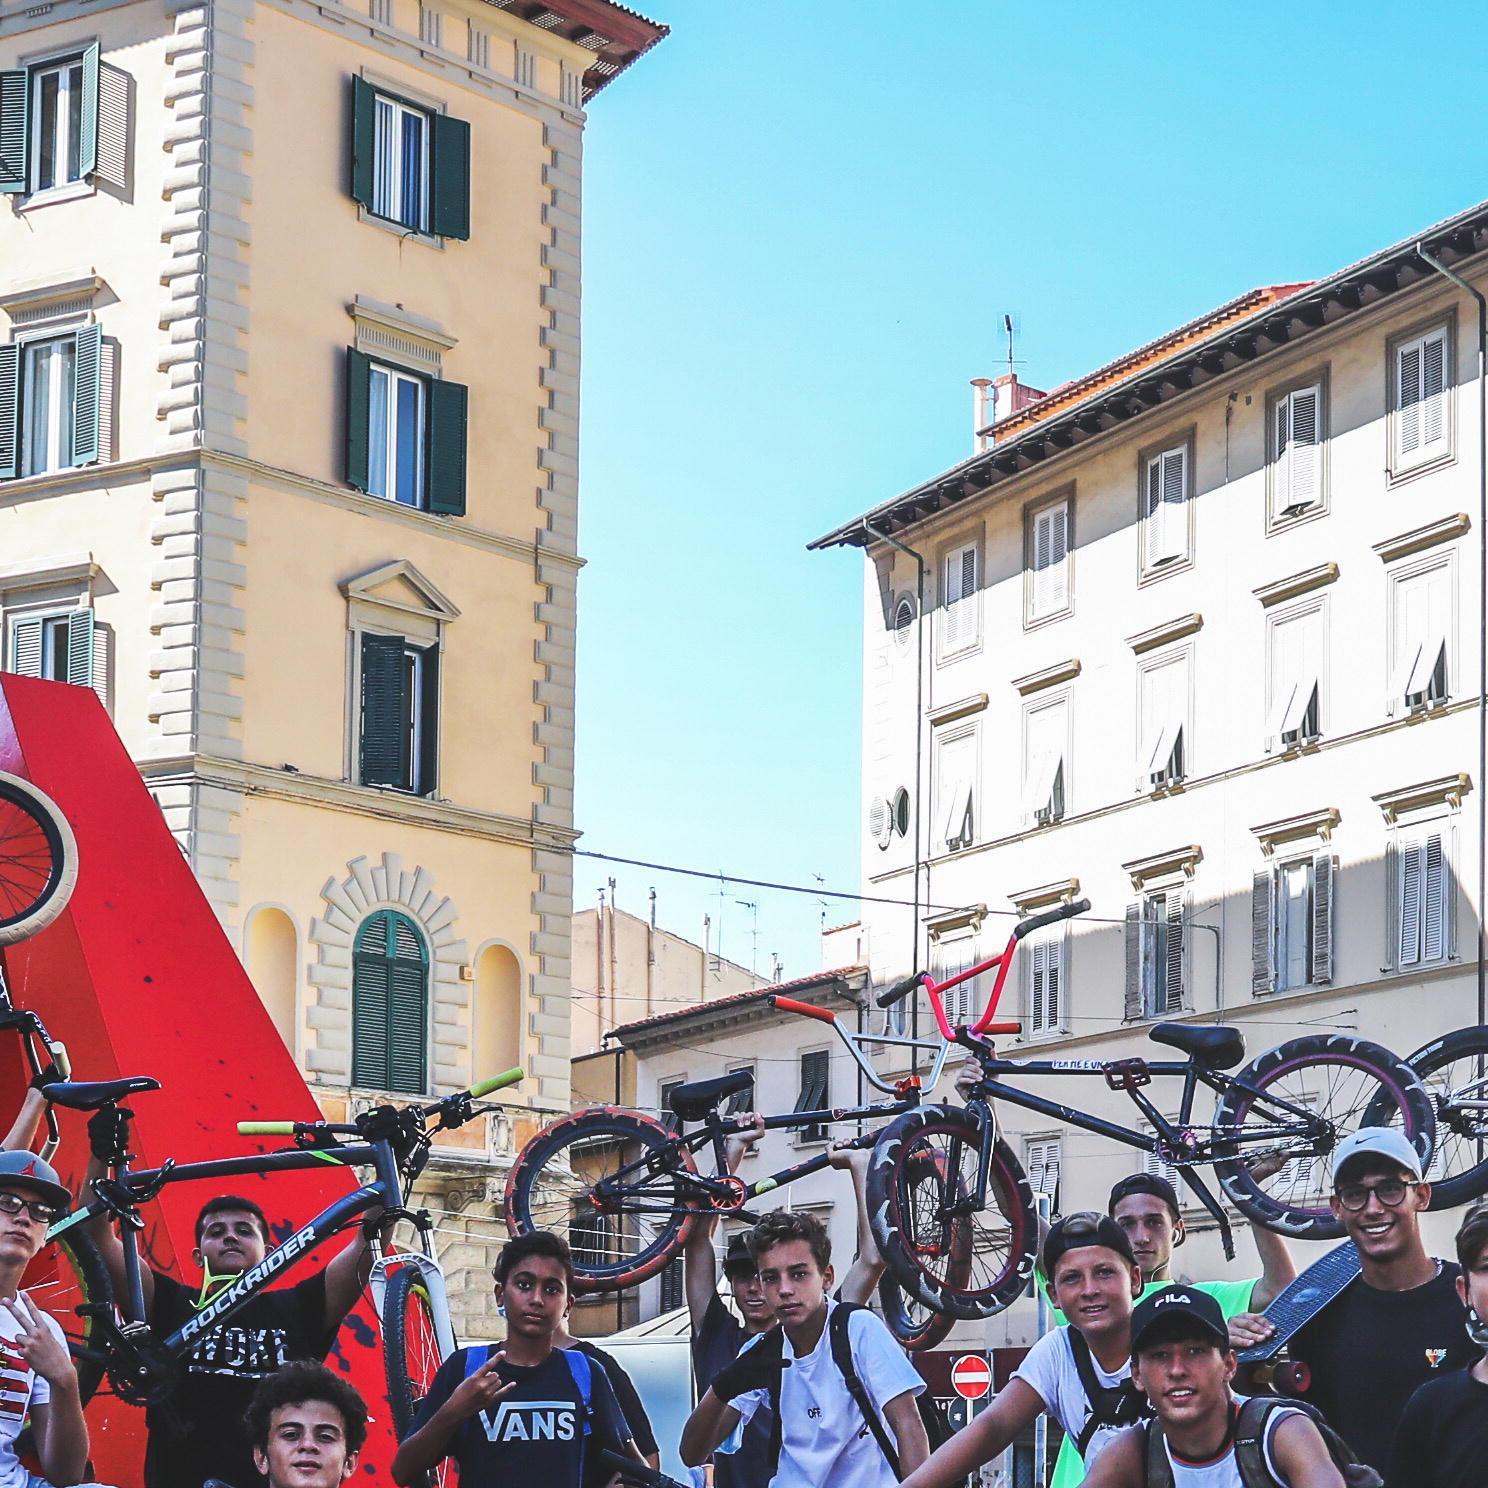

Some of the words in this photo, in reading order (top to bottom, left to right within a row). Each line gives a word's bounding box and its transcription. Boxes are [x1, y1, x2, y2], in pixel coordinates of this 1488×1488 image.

[180, 1225, 316, 1342] ROCKRIDER
[1154, 1293, 1191, 1308] FILA
[478, 1401, 576, 1442] VANS
